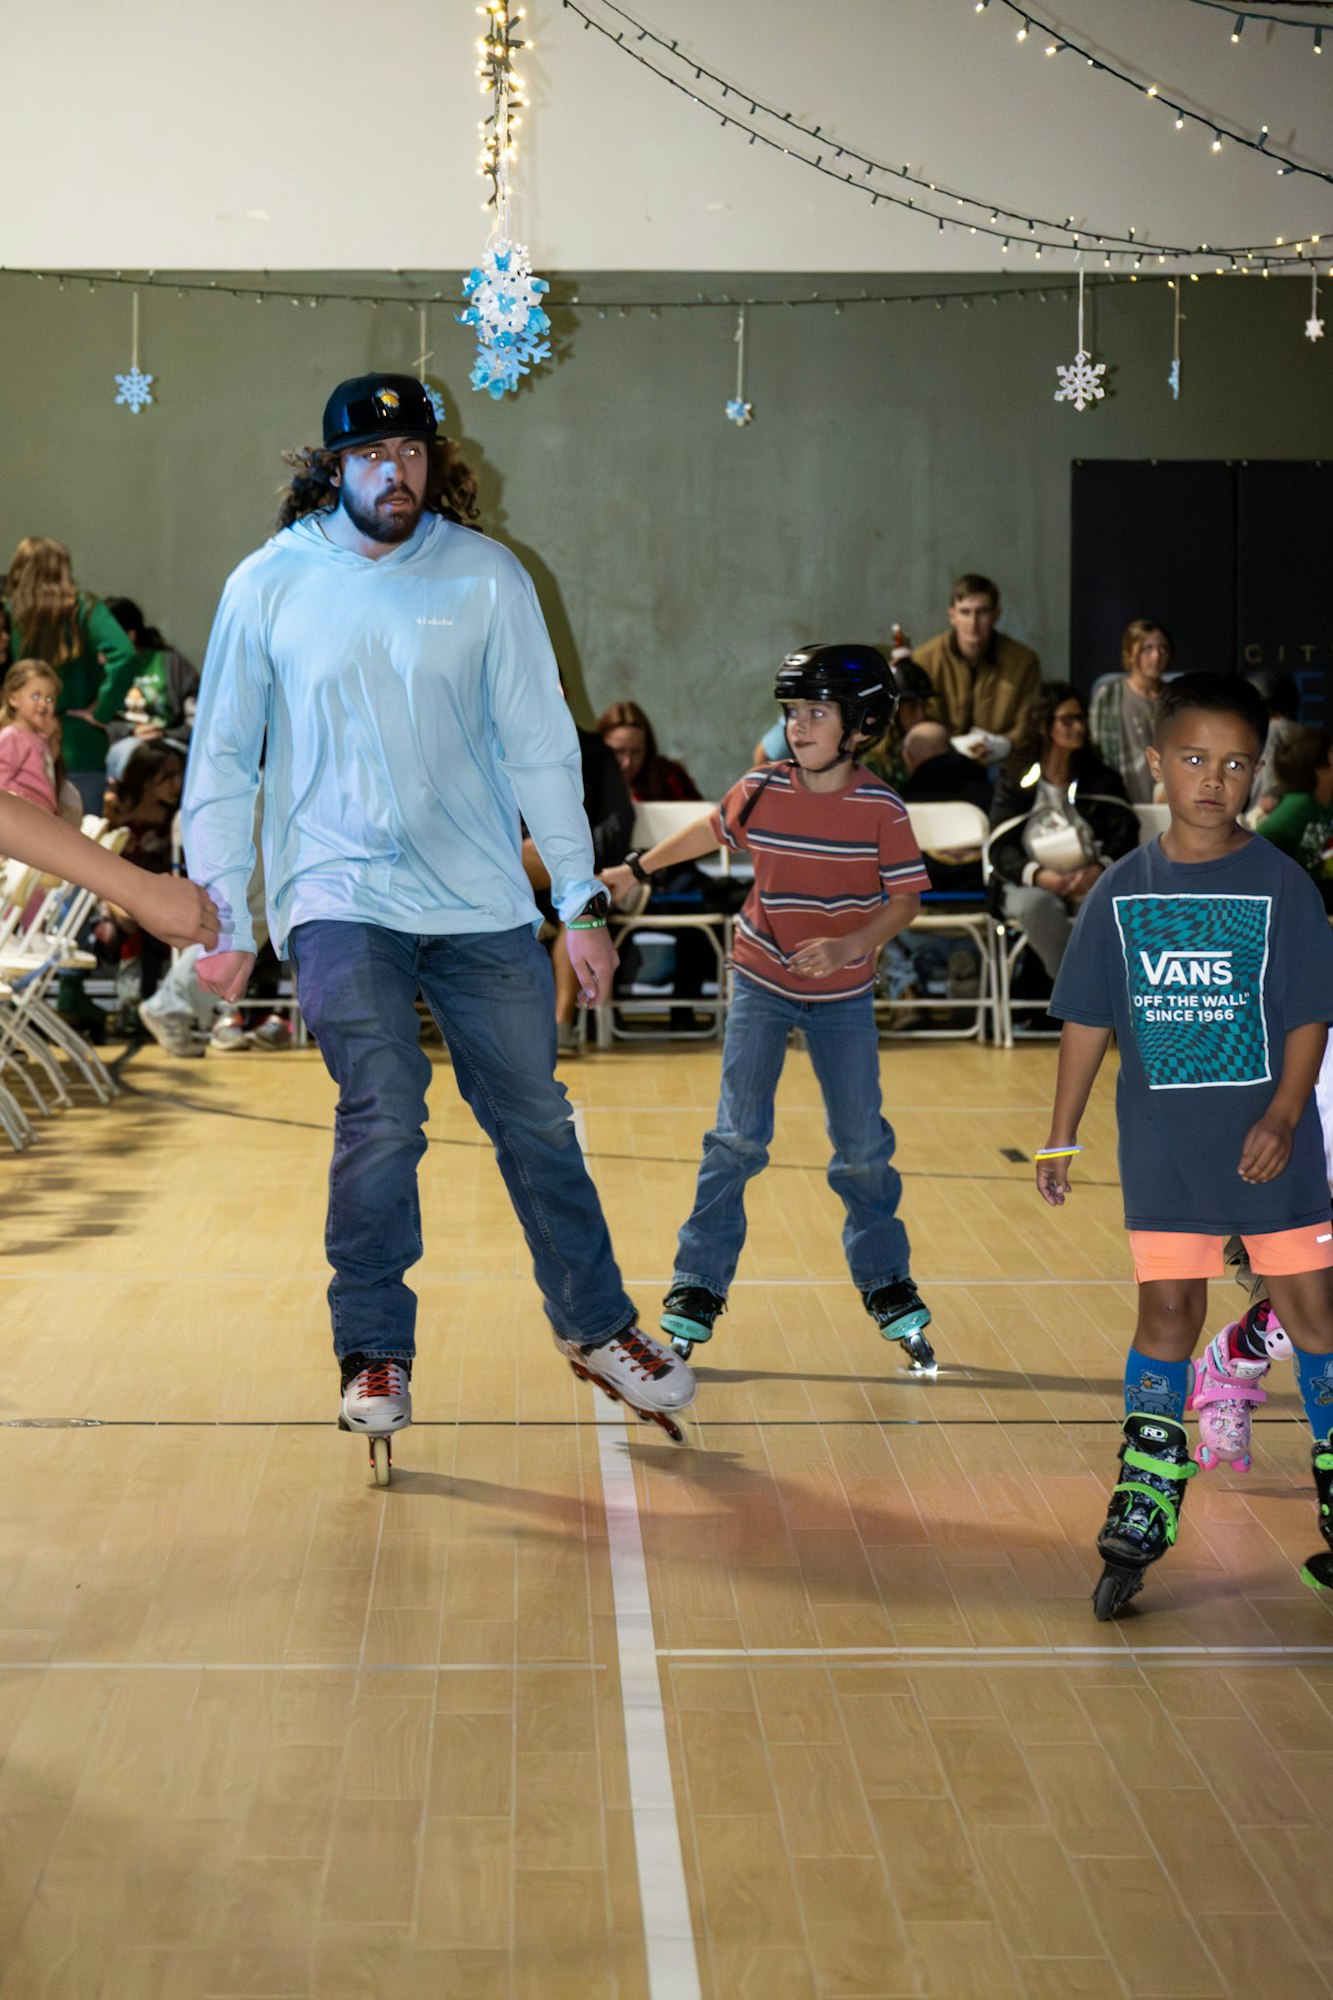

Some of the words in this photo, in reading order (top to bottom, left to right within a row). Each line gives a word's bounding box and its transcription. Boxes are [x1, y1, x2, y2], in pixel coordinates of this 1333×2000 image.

[1244, 643, 1333, 663] CIT
[1139, 950, 1233, 986] VANS
[1166, 994, 1199, 1007] THE
[1145, 1009, 1194, 1022] SINCE
[1197, 1008, 1235, 1022] 1966
